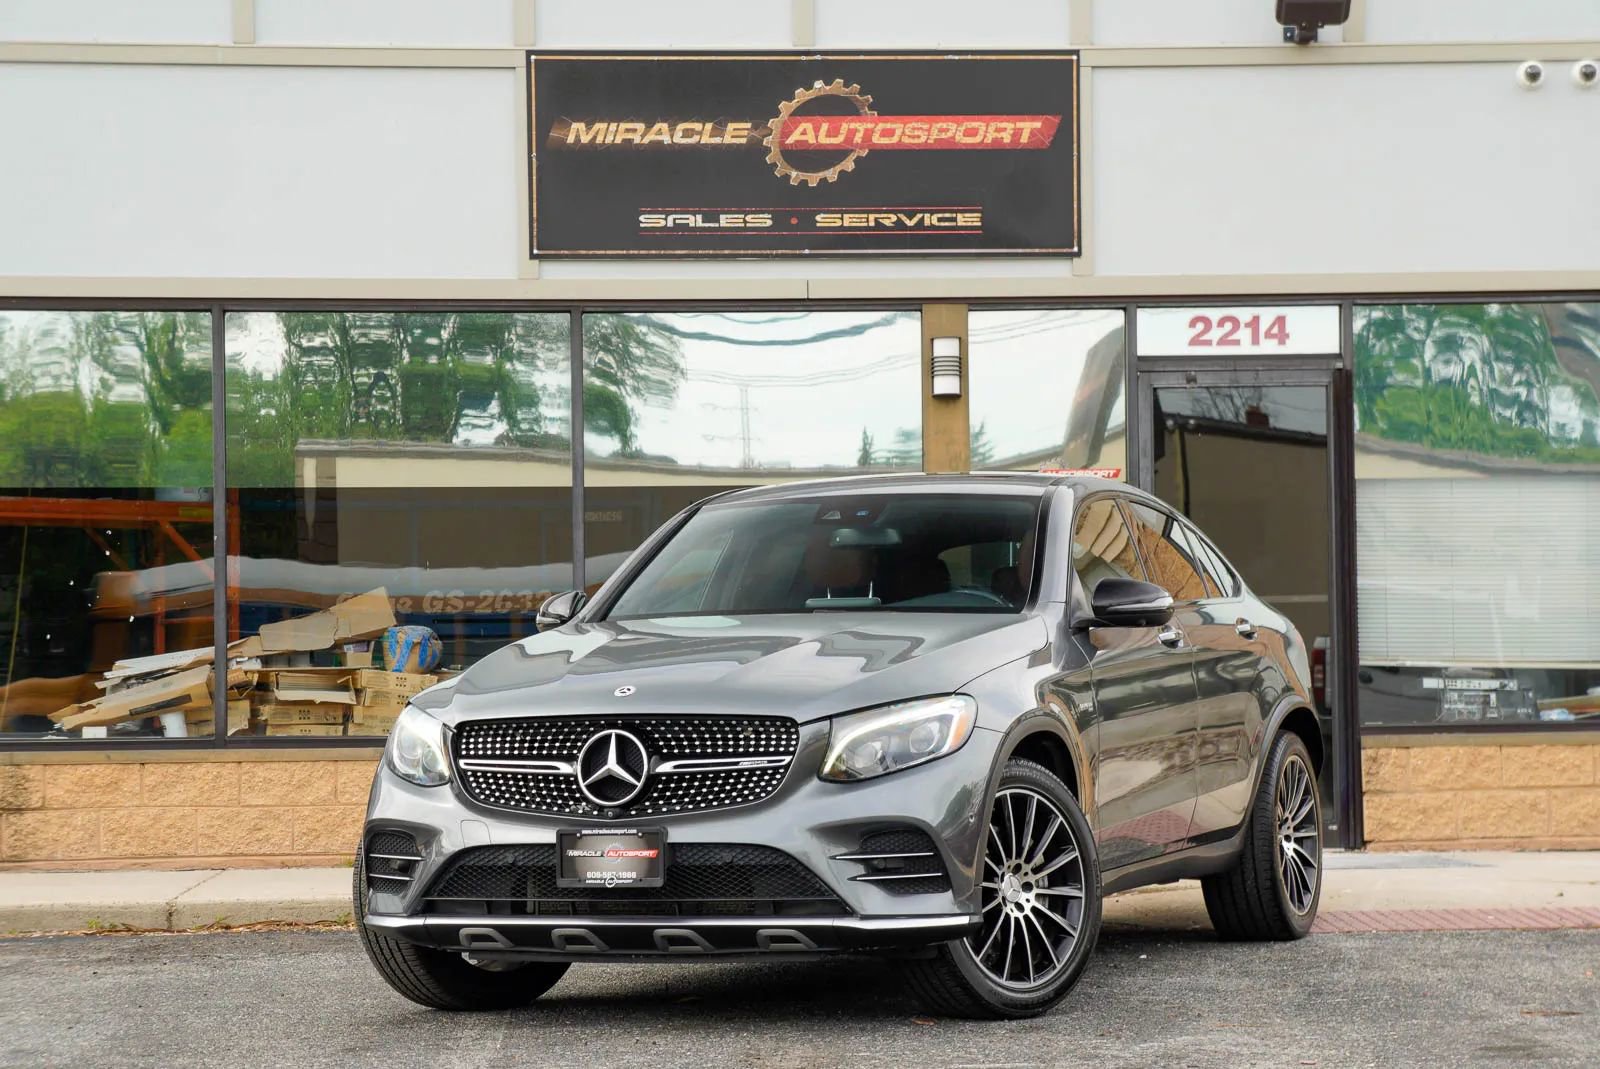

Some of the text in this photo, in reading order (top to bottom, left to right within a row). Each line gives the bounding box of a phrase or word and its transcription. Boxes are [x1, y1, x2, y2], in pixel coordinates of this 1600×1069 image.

[567, 121, 1043, 145] MIRACLE AUTOSPORT
[638, 212, 982, 228] SALES SERVICE
[1187, 315, 1290, 346] 2214
